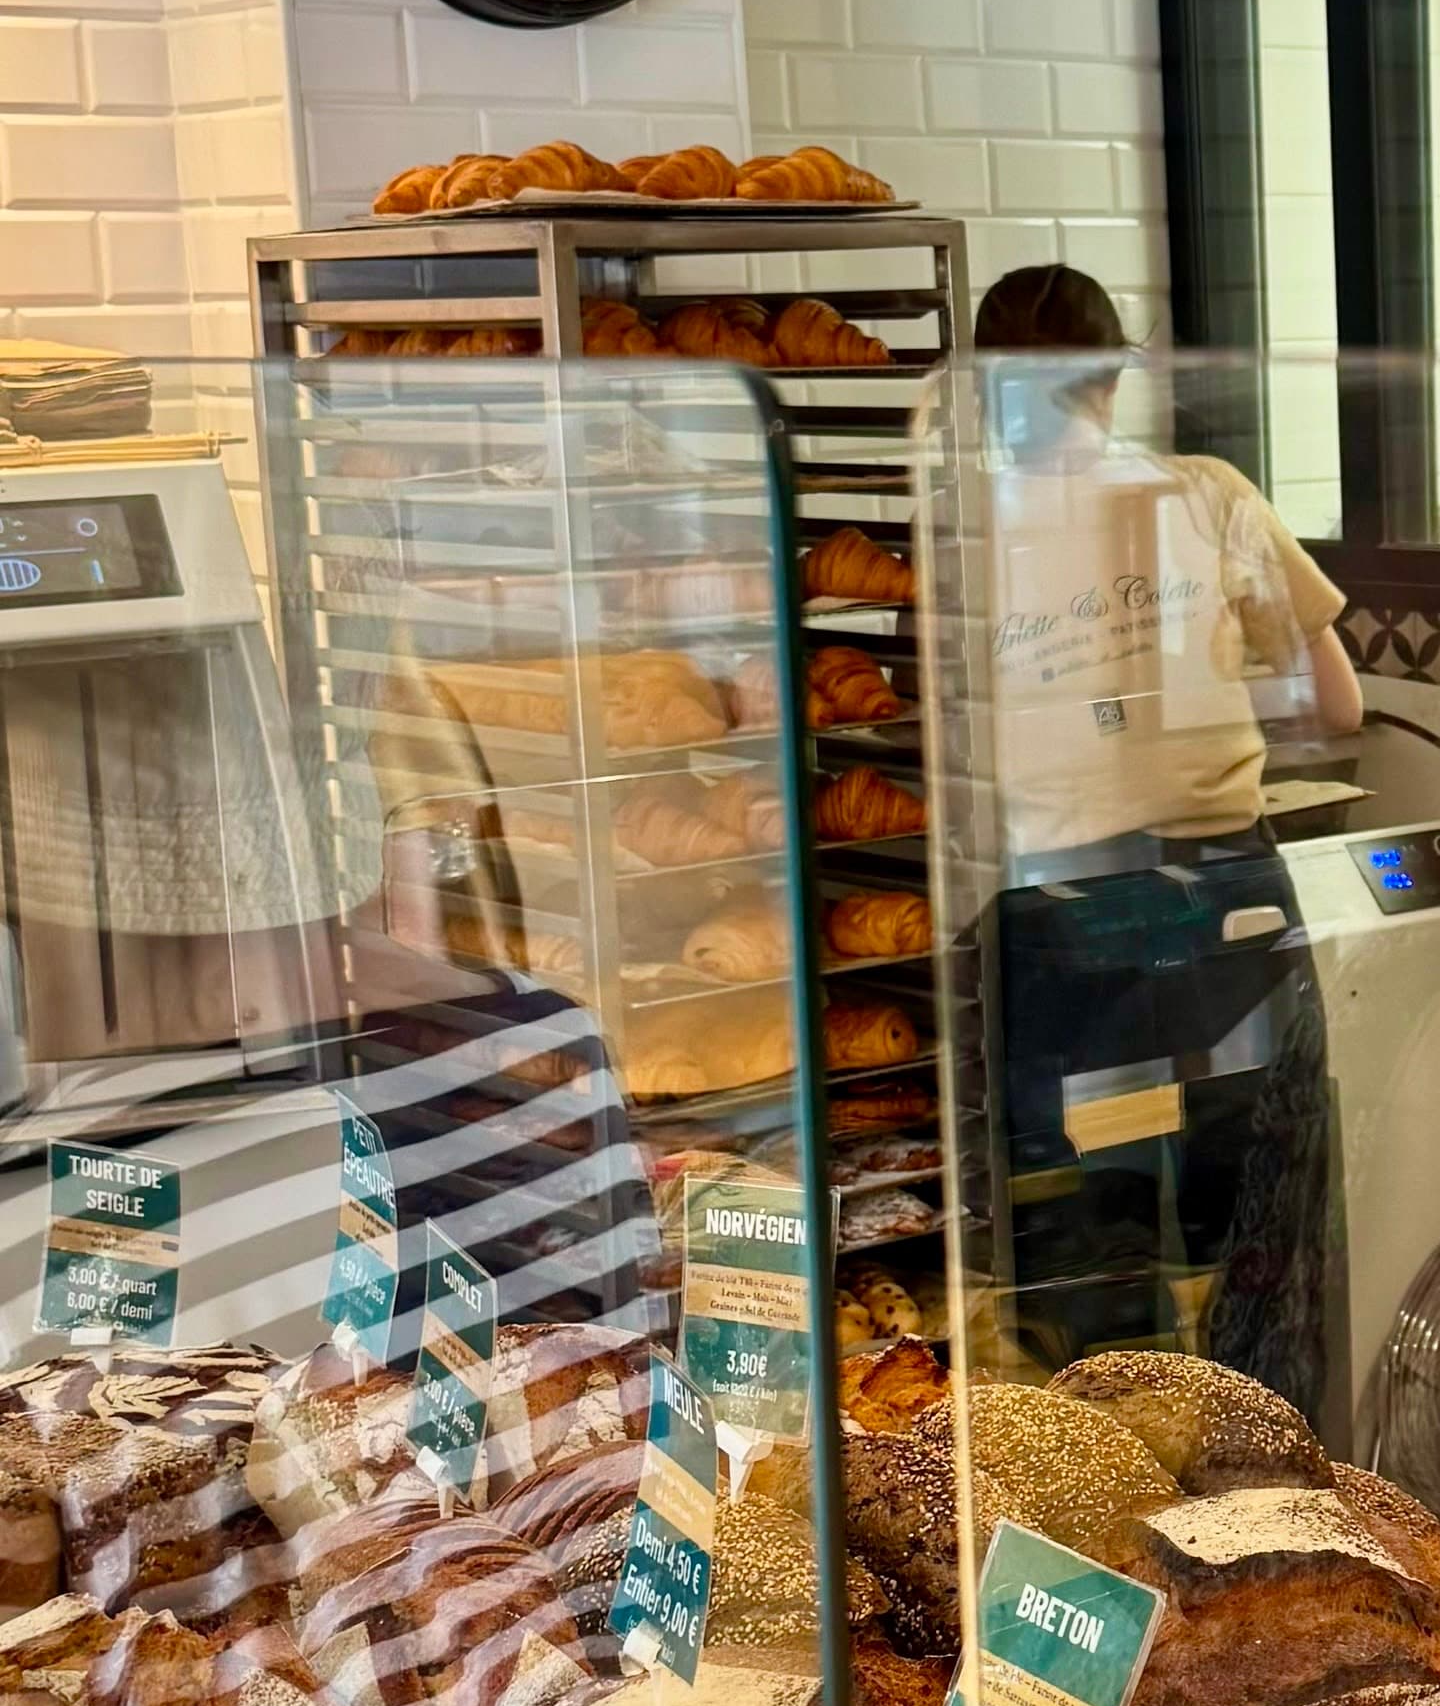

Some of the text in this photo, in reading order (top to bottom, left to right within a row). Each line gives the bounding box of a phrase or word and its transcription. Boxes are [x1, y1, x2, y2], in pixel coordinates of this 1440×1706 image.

[352, 1116, 378, 1157] PETIT
[69, 1154, 163, 1189] TOURTE DE
[86, 1189, 145, 1218] SEIGLE
[705, 1207, 808, 1246] NORVÉGIEN
[122, 1277, 158, 1297] quart
[442, 1260, 482, 1313] COMPLET
[121, 1301, 153, 1321] demi
[726, 1350, 768, 1378] 3,90€
[663, 1367, 704, 1435] MEULE
[636, 1516, 702, 1595] Demi 4,50 €
[623, 1564, 661, 1626] Entier
[661, 1592, 689, 1639] 9,00
[688, 1613, 699, 1647] €
[1015, 1583, 1105, 1654] BRETON
